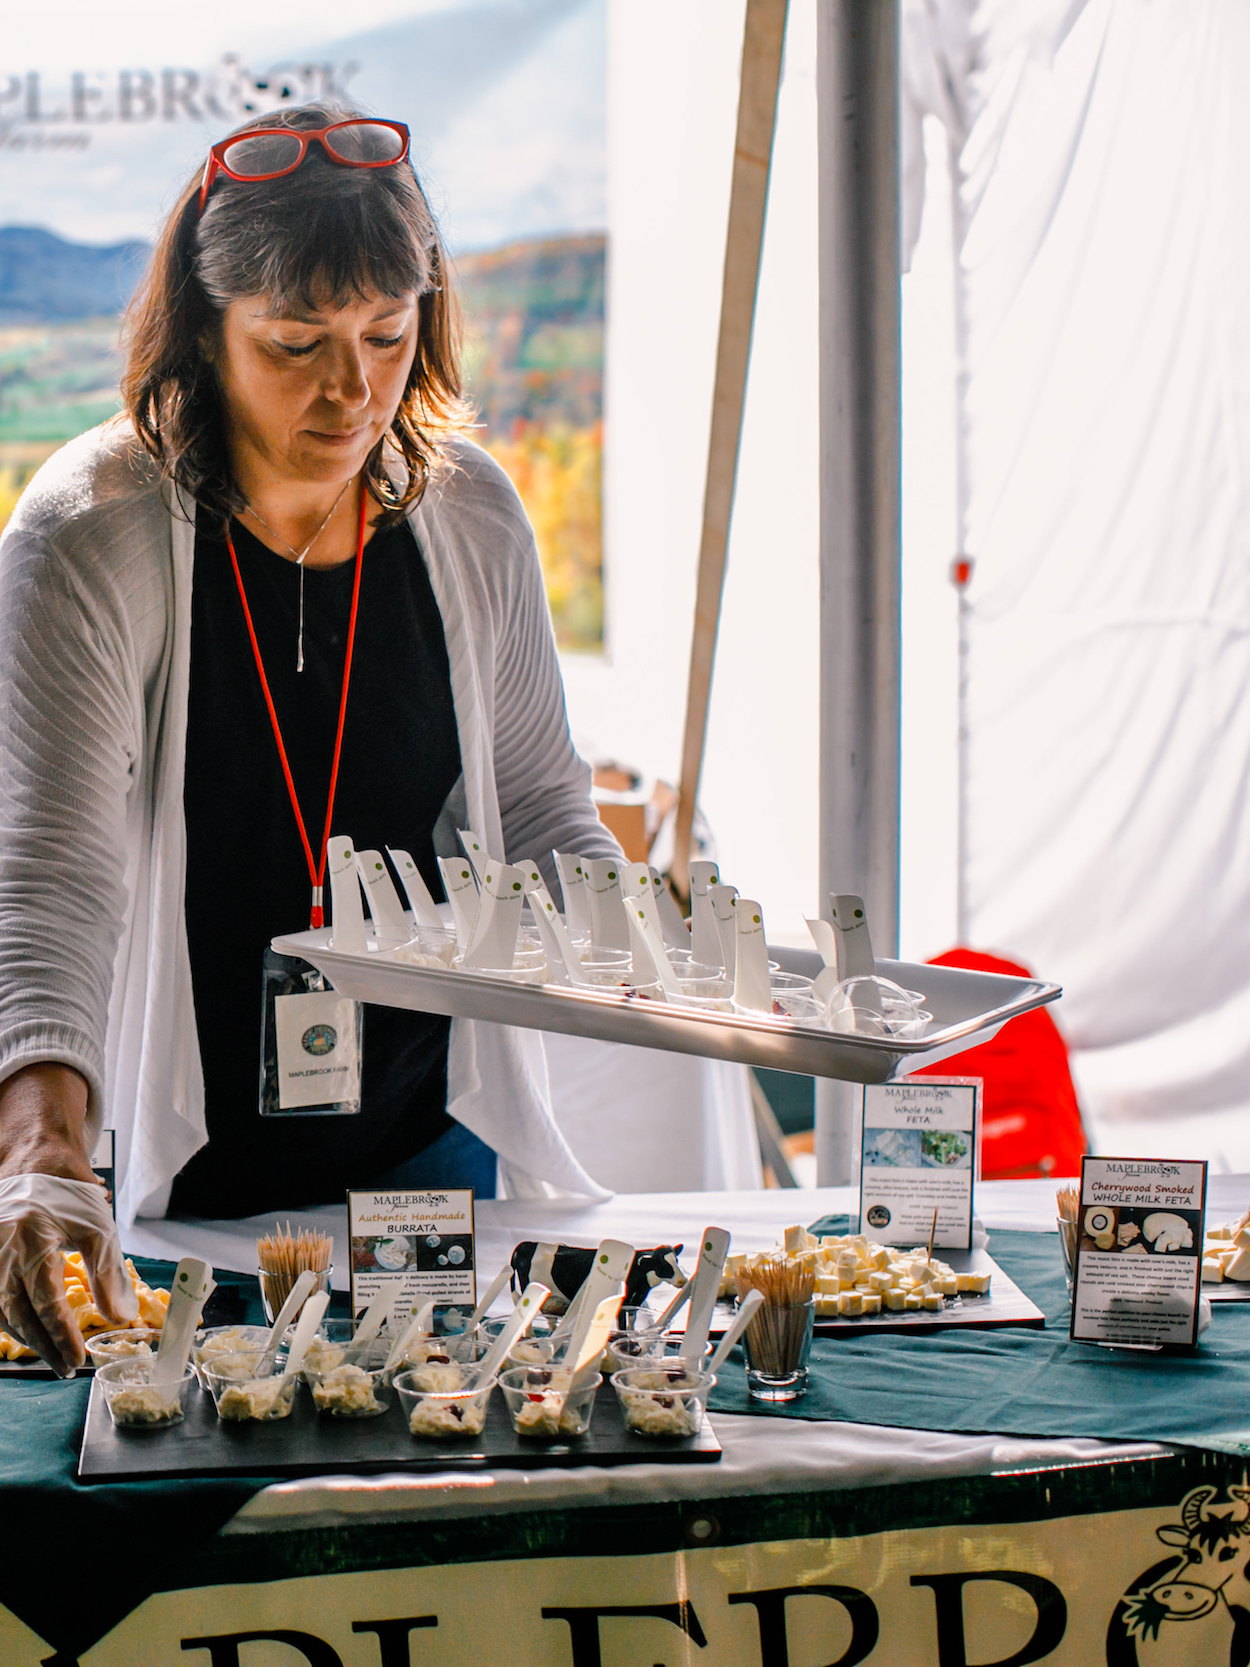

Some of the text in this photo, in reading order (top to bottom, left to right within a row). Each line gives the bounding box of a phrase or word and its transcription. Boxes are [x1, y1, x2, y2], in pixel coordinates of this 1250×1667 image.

[288, 1068, 332, 1078] MAPLEBROOK
[894, 1106, 944, 1115] Whole Milk
[906, 1116, 931, 1124] FETA
[1105, 1164, 1181, 1176] MAPLEBROOK
[1091, 1182, 1194, 1195] Cherrywood Smoked
[373, 1194, 449, 1206] MAPLEBROOK
[1093, 1193, 1192, 1205] WHOLE MILK FETA
[358, 1211, 466, 1223] Authentic Handmade
[387, 1224, 438, 1234] BURRATA
